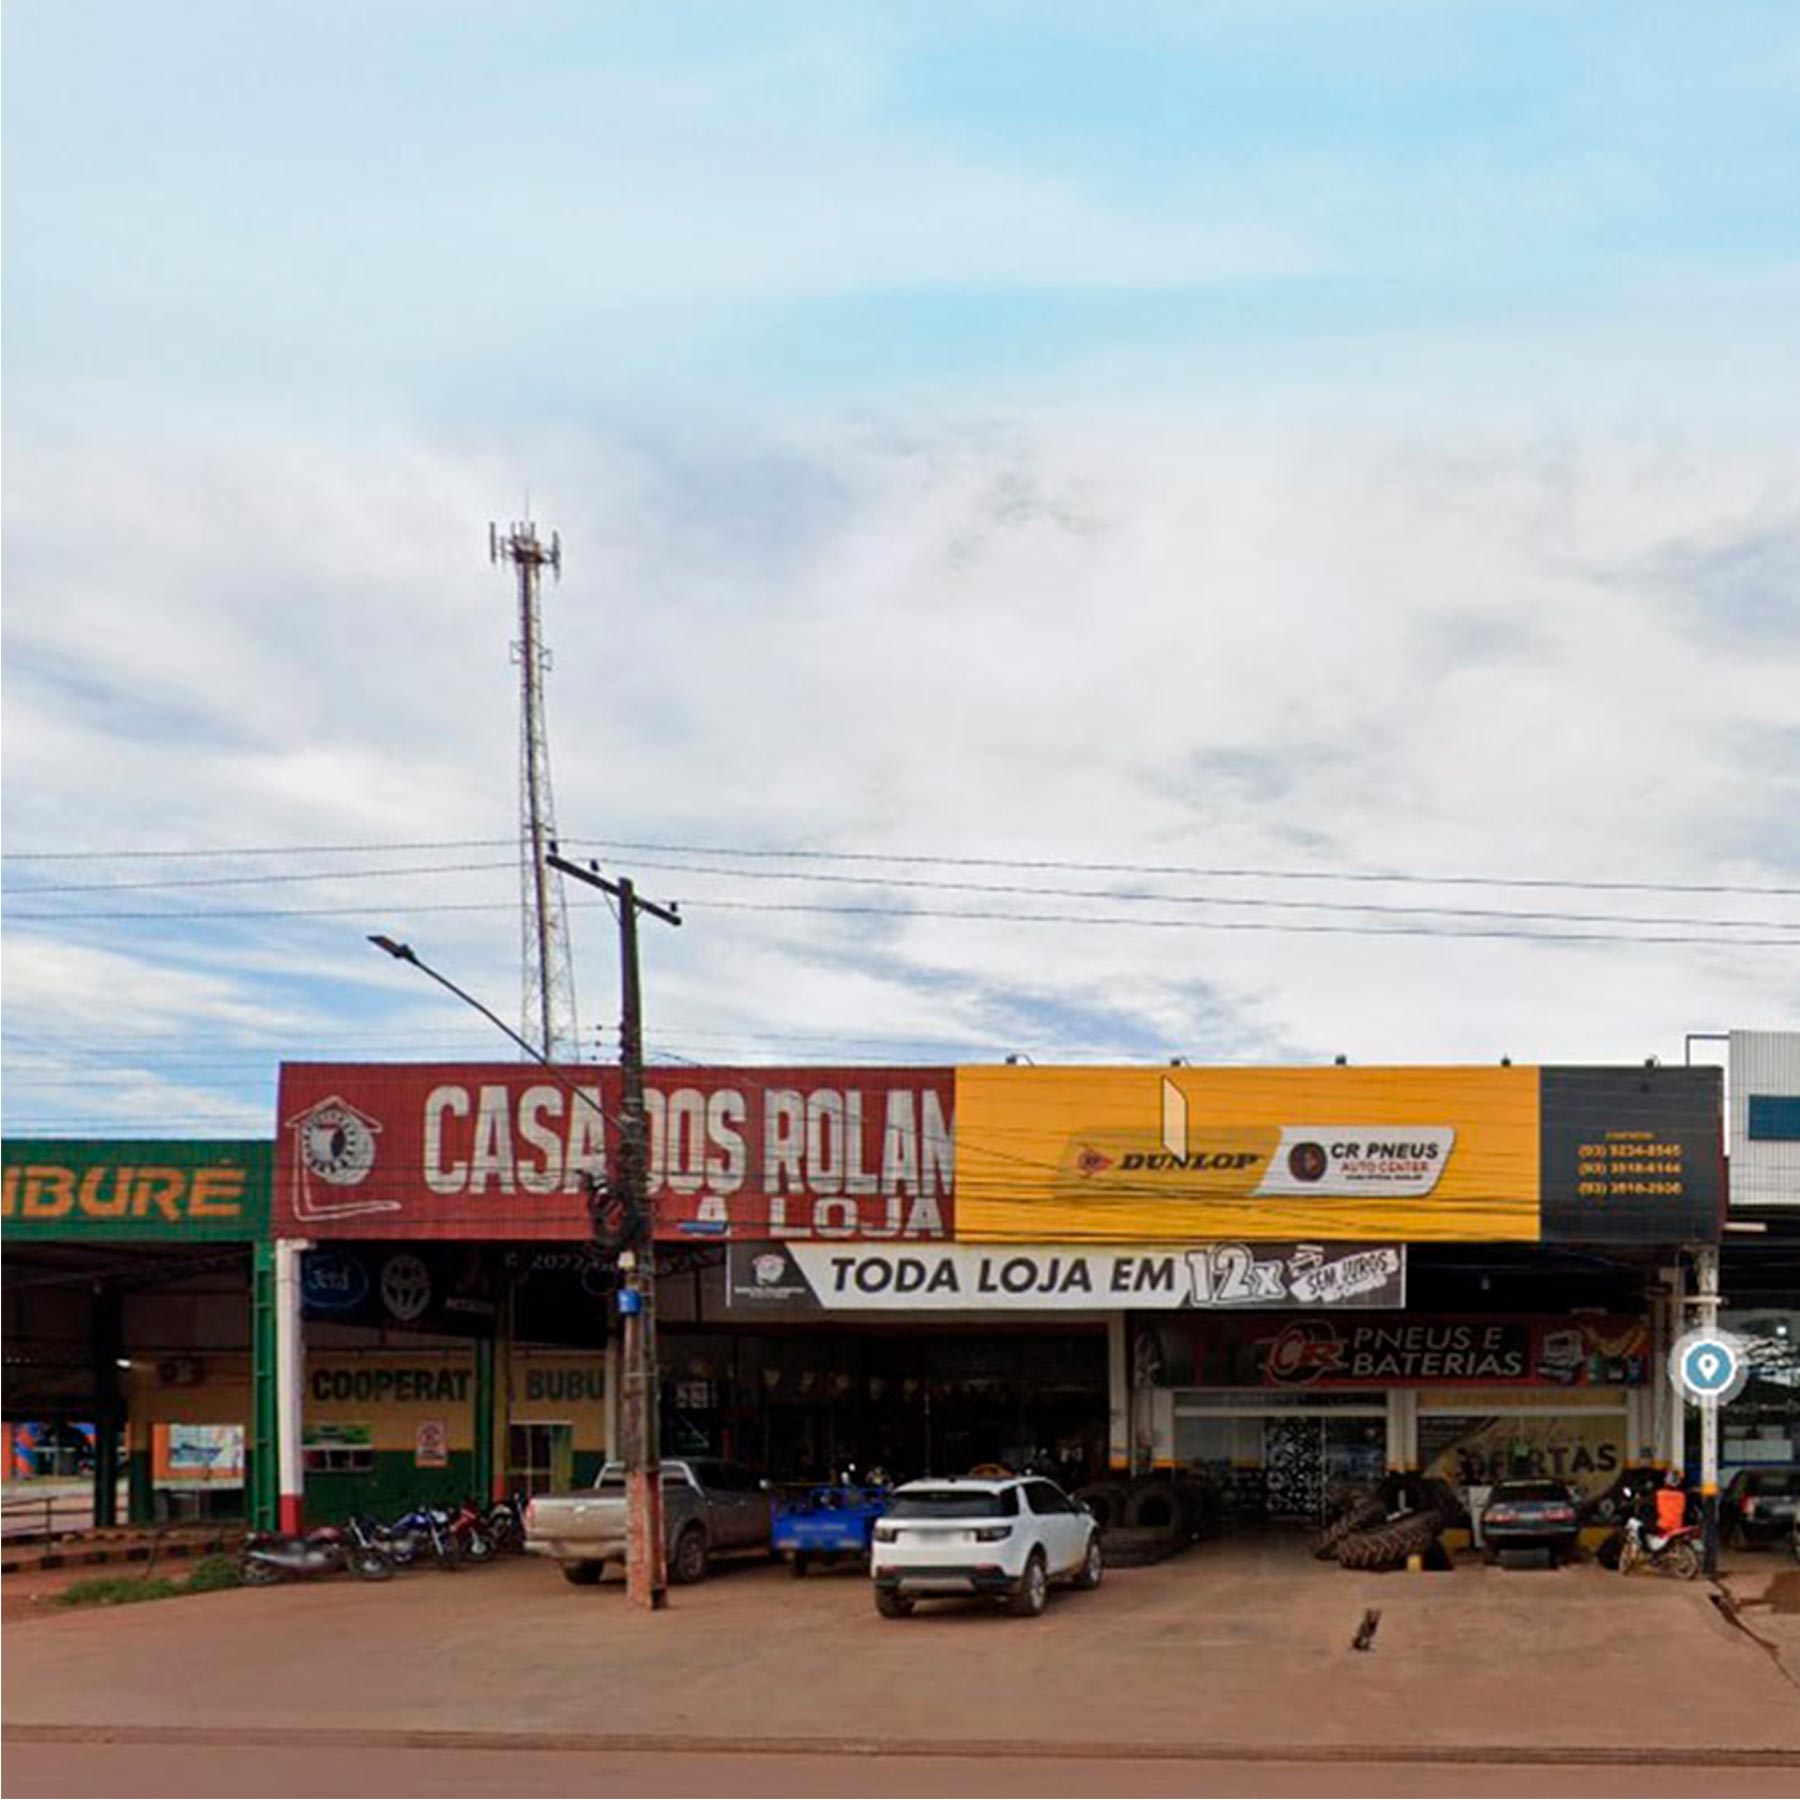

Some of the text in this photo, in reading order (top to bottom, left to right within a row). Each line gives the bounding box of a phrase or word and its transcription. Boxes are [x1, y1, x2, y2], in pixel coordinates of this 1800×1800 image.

[424, 1085, 606, 1194] CASA
[1331, 1143, 1439, 1159] CR PNEUS
[1121, 1153, 1261, 1171] DUNLOP
[697, 1196, 944, 1238] A LOJA
[830, 1256, 960, 1293] TODA
[978, 1257, 1092, 1293] LOJA
[1110, 1257, 1175, 1292] EM
[1187, 1244, 1285, 1302] 12x
[1352, 1327, 1472, 1350] PNEUS
[1483, 1327, 1504, 1350] E
[1352, 1352, 1523, 1376] BATERIAS
[312, 1369, 473, 1402] COOPERAT
